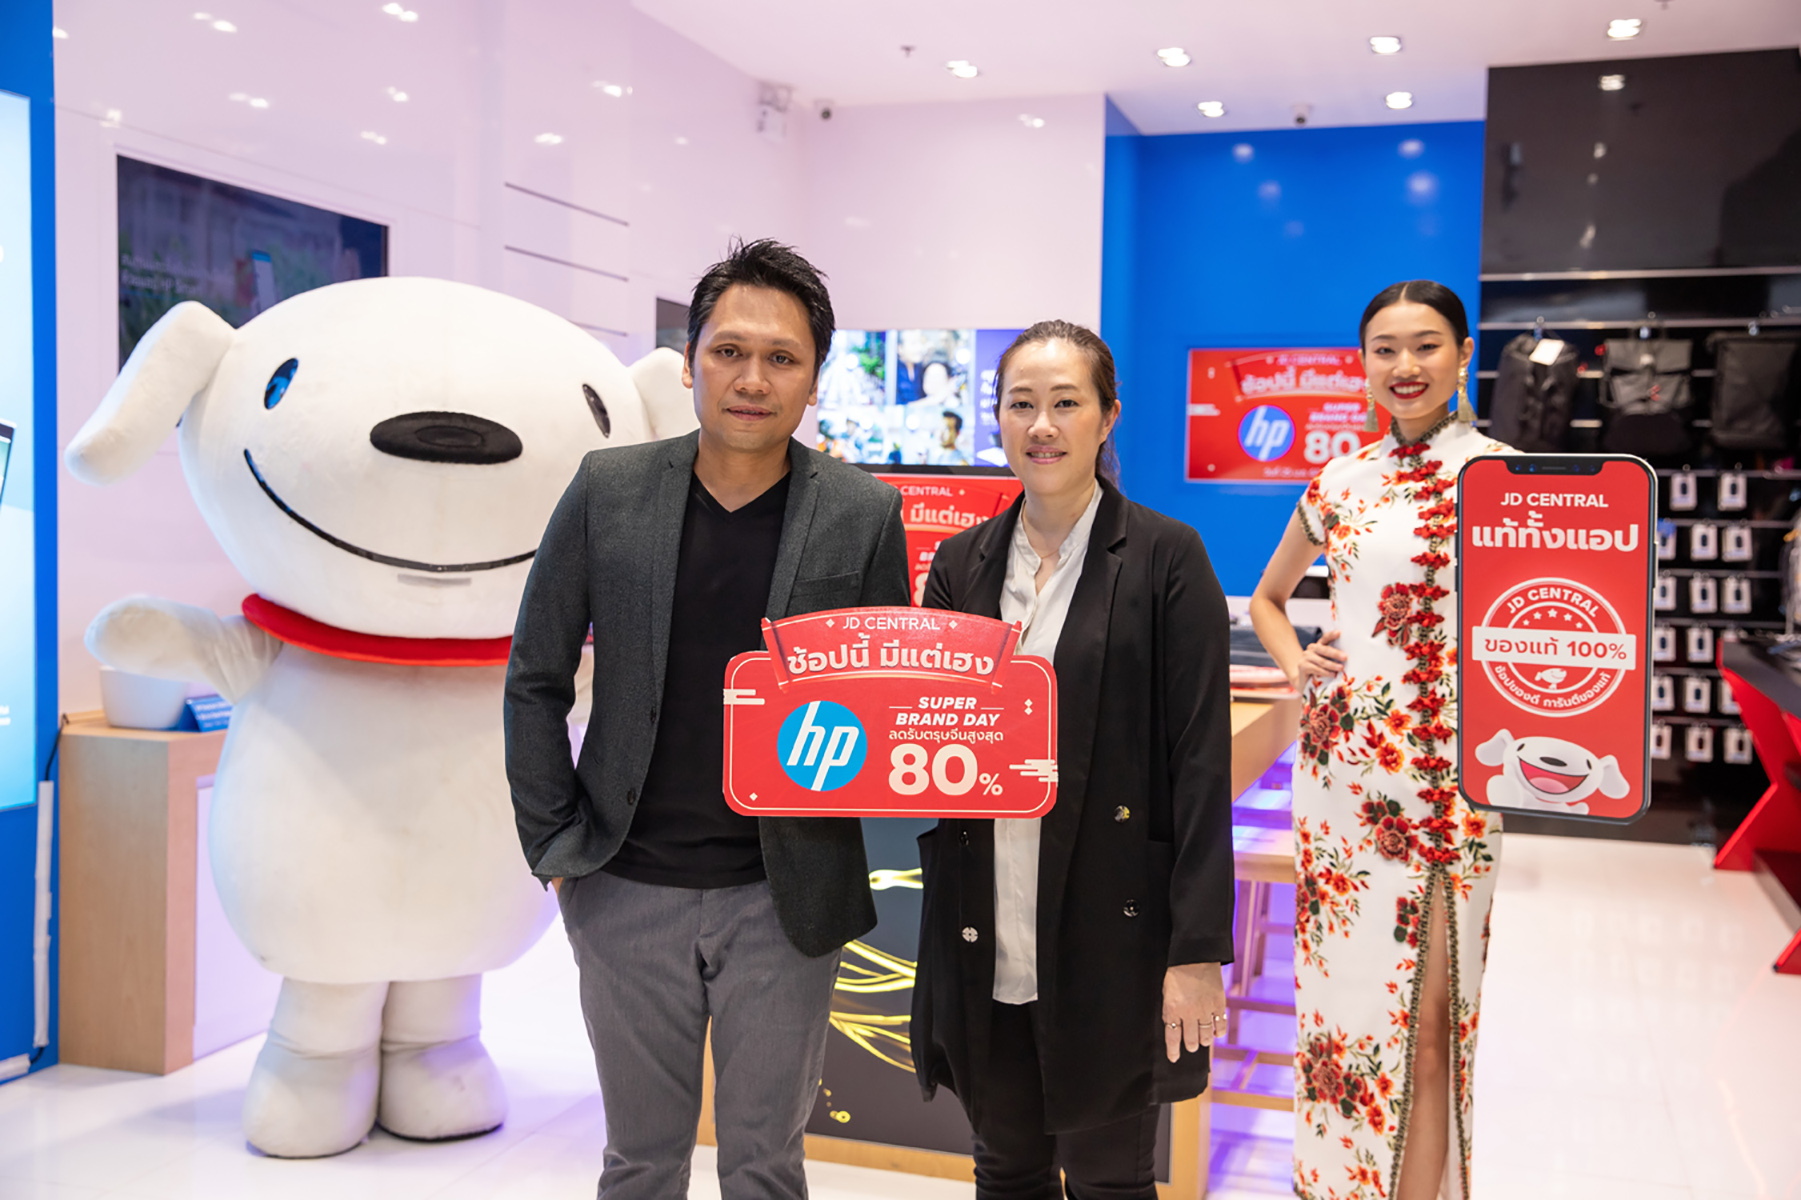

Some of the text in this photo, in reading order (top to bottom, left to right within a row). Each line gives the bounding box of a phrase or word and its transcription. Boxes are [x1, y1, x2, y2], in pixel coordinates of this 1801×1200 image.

[1300, 368, 1366, 393] มีแต่เฮ
[1244, 405, 1290, 461] hp
[900, 485, 953, 497] CENTRAL
[1500, 492, 1609, 508] JD CENTRAL
[1472, 510, 1639, 552] แท้ทั้งแอป
[1507, 587, 1600, 618] JD CENTRAL
[843, 617, 940, 630] JD CENTRAL
[787, 632, 995, 675] ช้อปนี้ มีแต่เฮง
[1484, 637, 1627, 660] ของแท้ 100%
[1495, 665, 1541, 705] ช้อปของดี
[918, 697, 977, 709] SUPER
[895, 712, 1000, 726] BRAND DAY
[786, 700, 859, 792] hp
[889, 727, 1004, 744] ลดรับตรุษจีนสูงสุด
